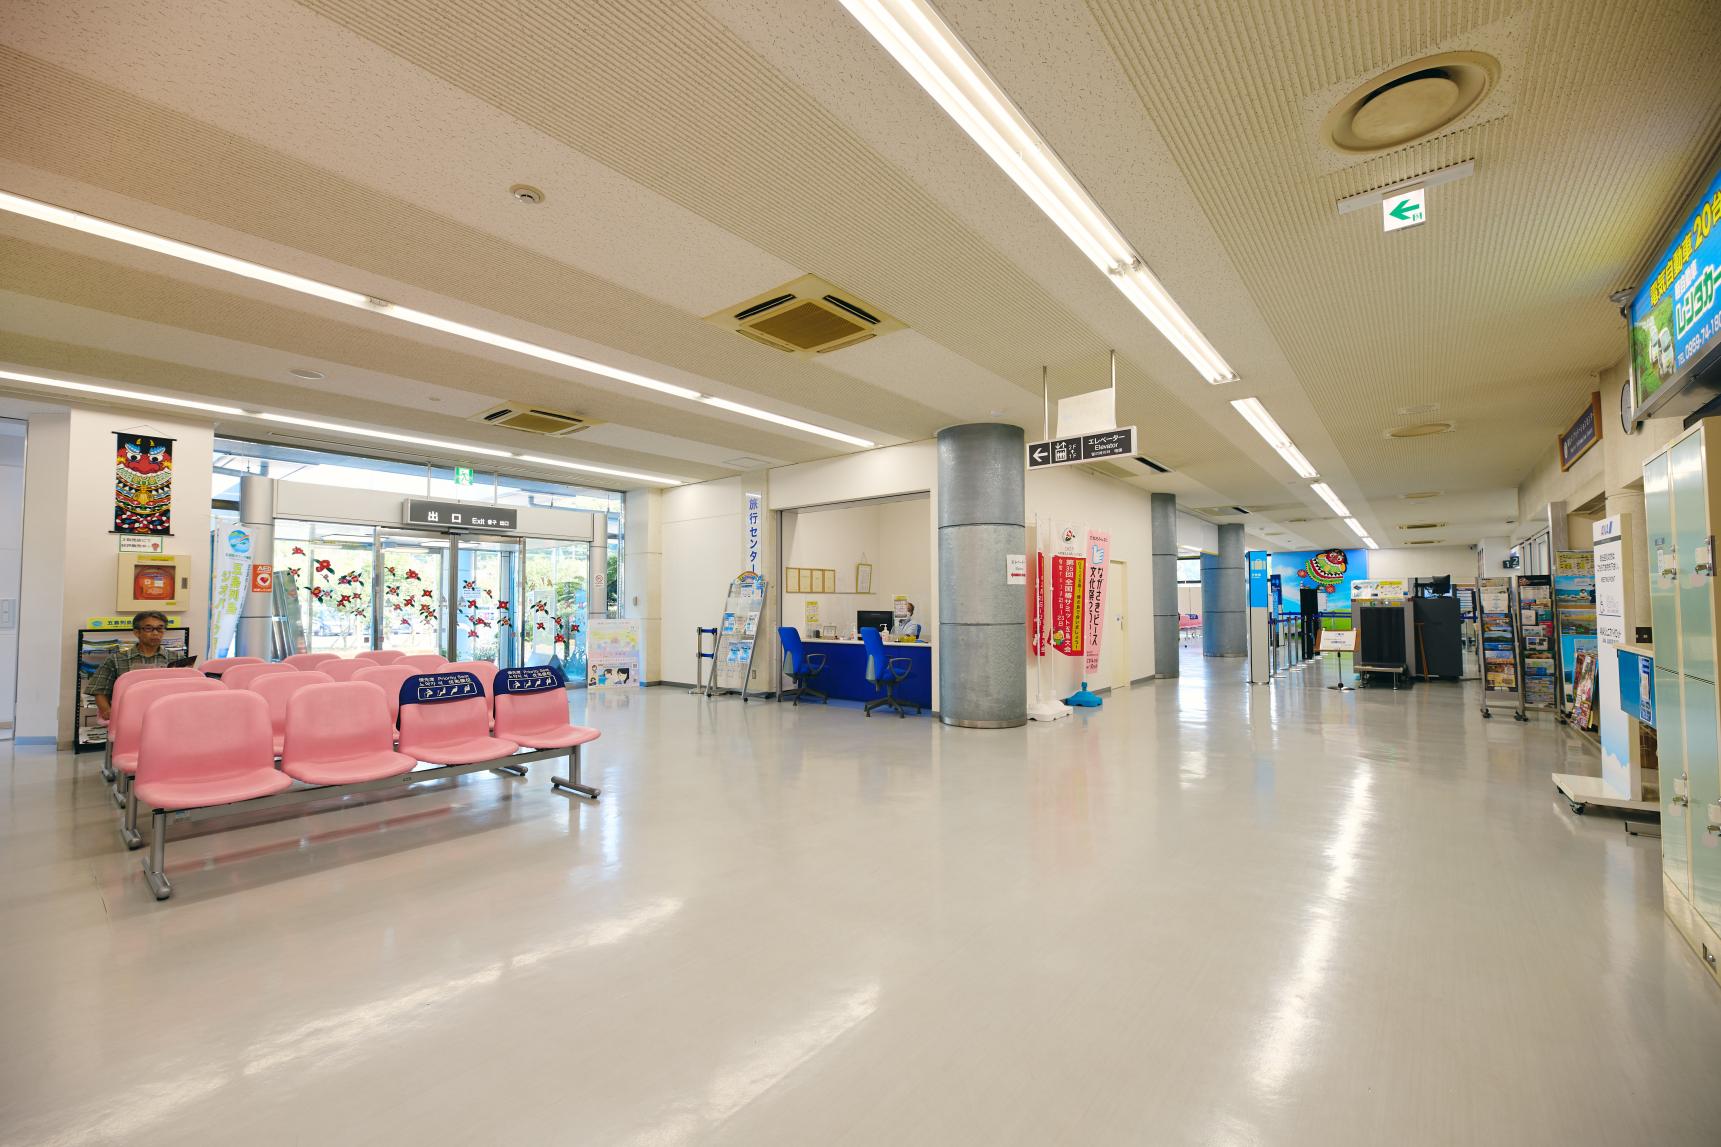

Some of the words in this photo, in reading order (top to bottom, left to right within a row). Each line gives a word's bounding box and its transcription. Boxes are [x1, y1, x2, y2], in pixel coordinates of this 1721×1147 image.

[1088, 434, 1126, 445] エレベーター
[472, 517, 485, 525] Exit
[749, 499, 757, 572] 旅行センター
[1092, 567, 1104, 646] ながさきピース
